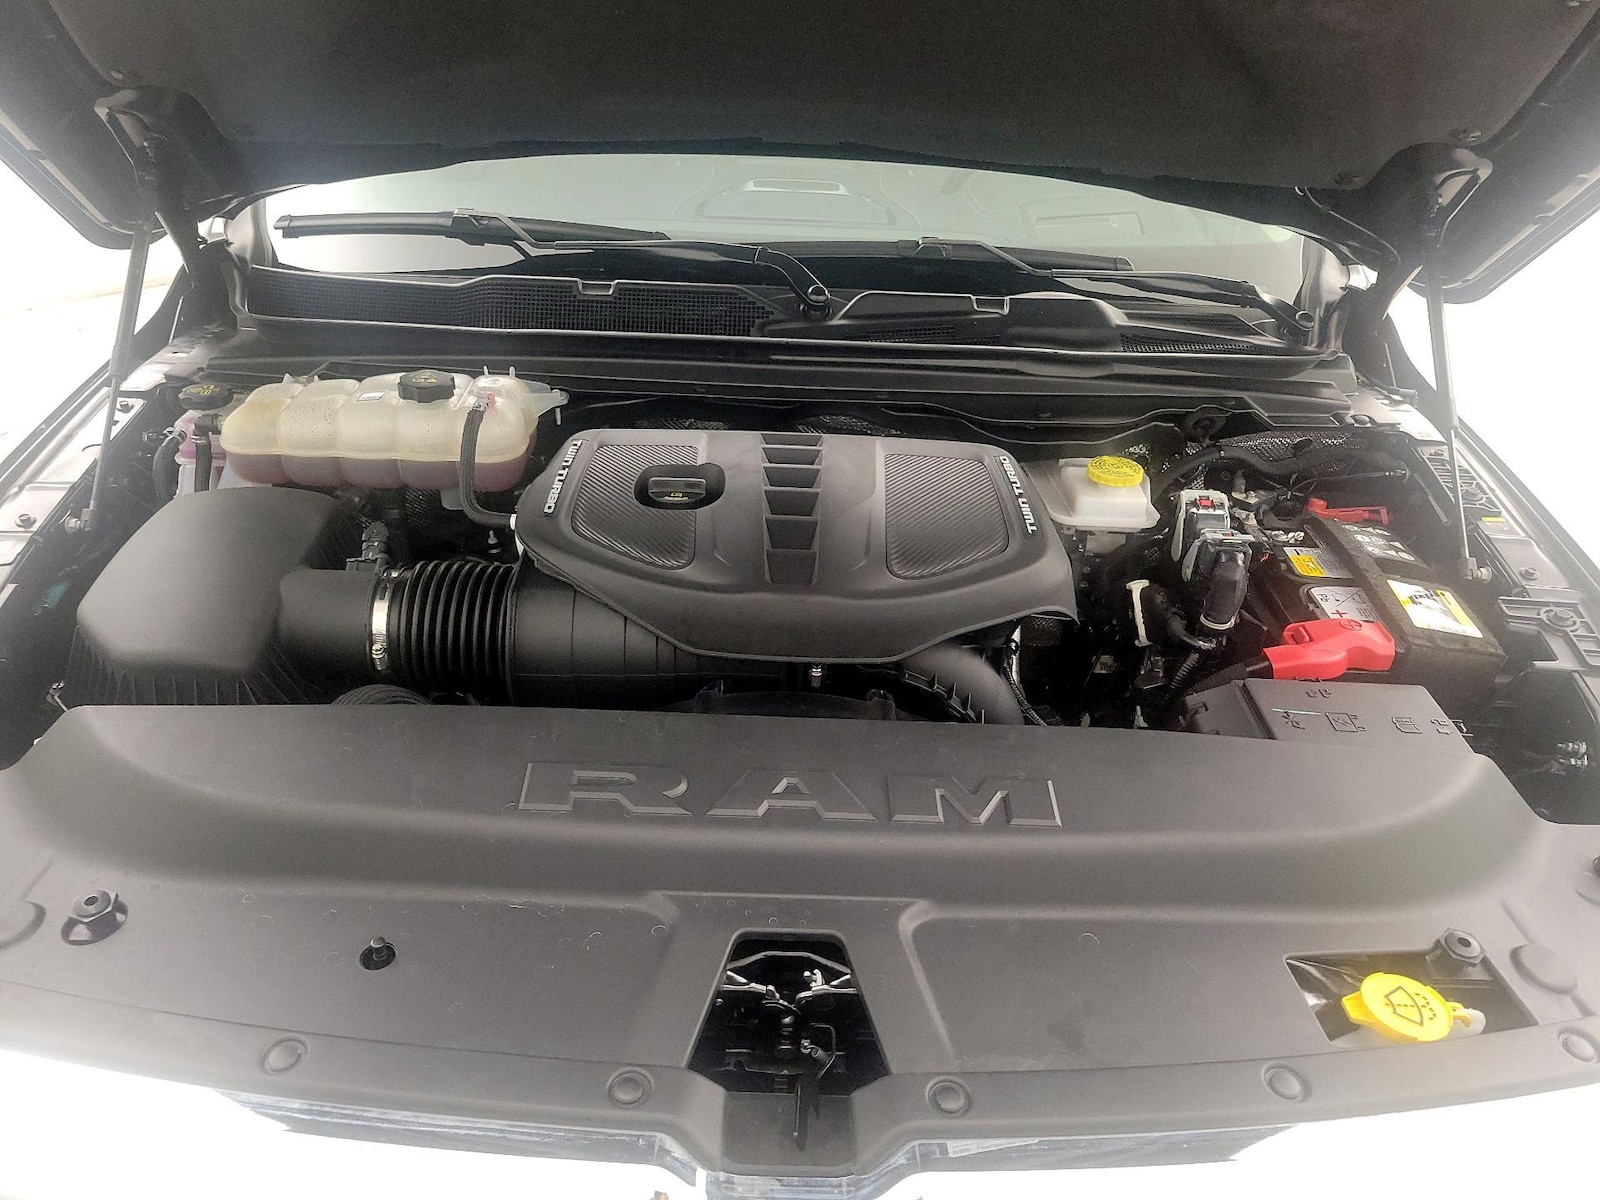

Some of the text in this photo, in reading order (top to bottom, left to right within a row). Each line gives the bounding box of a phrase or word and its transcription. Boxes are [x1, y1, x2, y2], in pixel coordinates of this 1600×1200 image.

[543, 439, 583, 514] TWIN TURBO
[1000, 456, 1037, 534] TWIN TURBO
[518, 761, 1063, 828] RAM
